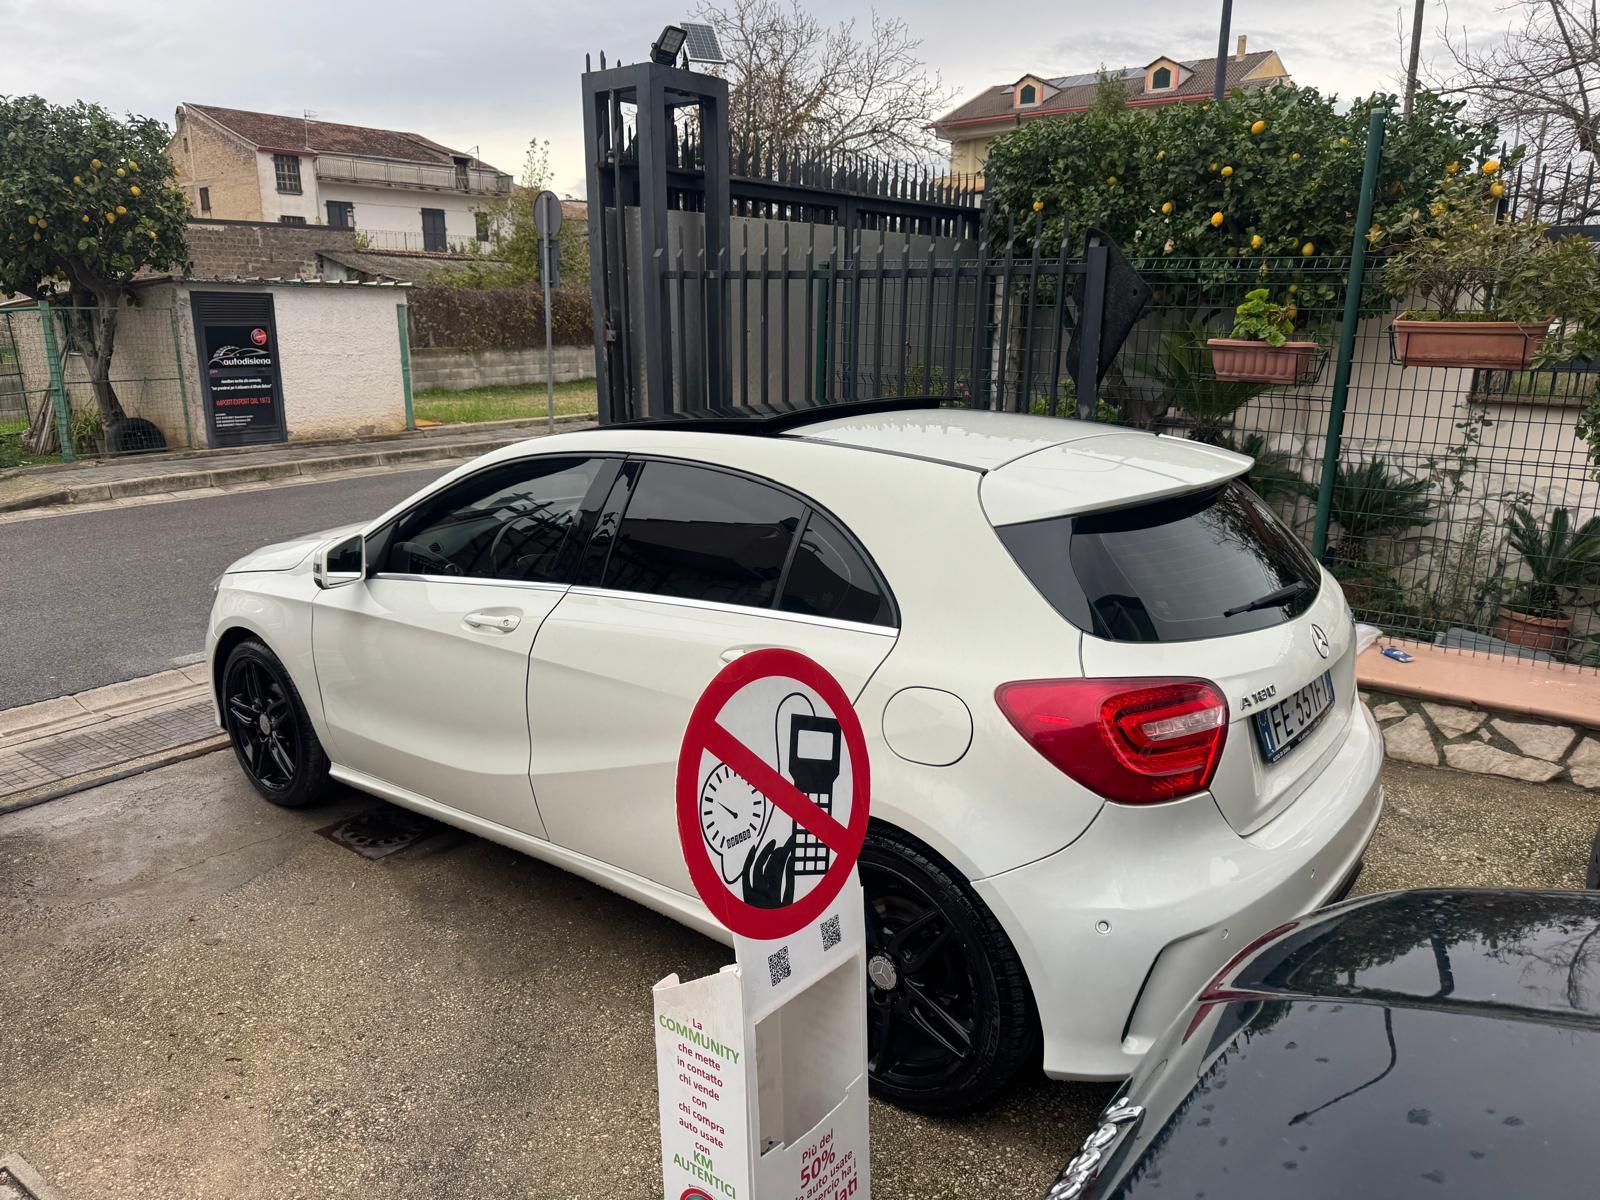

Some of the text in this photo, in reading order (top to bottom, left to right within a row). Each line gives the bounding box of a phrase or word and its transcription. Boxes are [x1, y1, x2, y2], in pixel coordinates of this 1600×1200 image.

[223, 357, 271, 366] autodisiena
[1270, 698, 1294, 745] FE
[659, 1014, 740, 1064] COMMUNITY
[692, 1018, 703, 1031] La
[677, 1056, 723, 1087] in contatto
[678, 1042, 721, 1071] che mette
[679, 1073, 720, 1101] chi vende
[692, 1095, 707, 1109] con
[678, 1102, 725, 1135] chi compra
[679, 1117, 724, 1149] auto usate
[693, 1150, 713, 1172] KM
[695, 1141, 710, 1156] con
[801, 1127, 834, 1164] Più del
[673, 1153, 736, 1199] AUTENTICI
[800, 1143, 836, 1189] 50%
[806, 1150, 853, 1199] auto usate
[841, 1165, 852, 1181] ha
